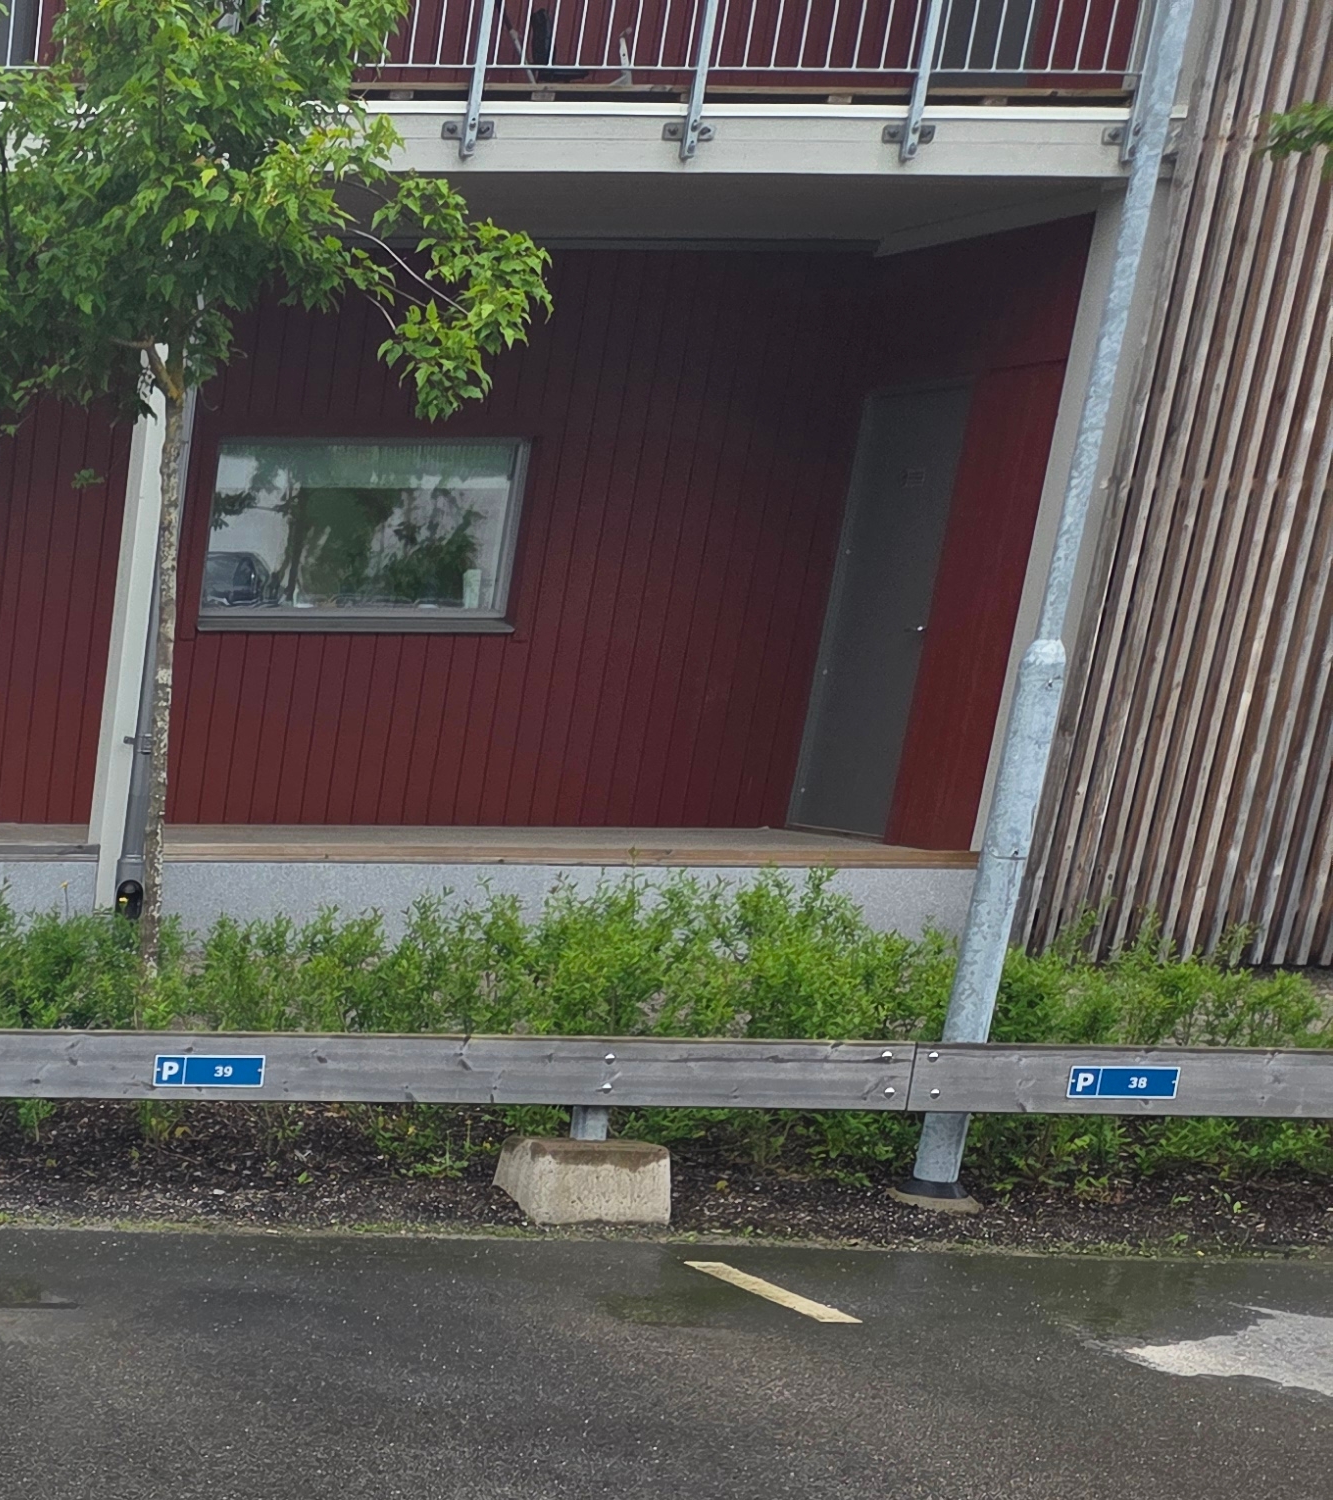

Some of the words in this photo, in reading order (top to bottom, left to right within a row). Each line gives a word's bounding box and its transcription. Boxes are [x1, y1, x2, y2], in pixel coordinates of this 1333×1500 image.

[161, 1061, 179, 1081] P
[213, 1066, 233, 1078] 39
[1075, 1072, 1095, 1092] P
[1127, 1076, 1148, 1089] 38
